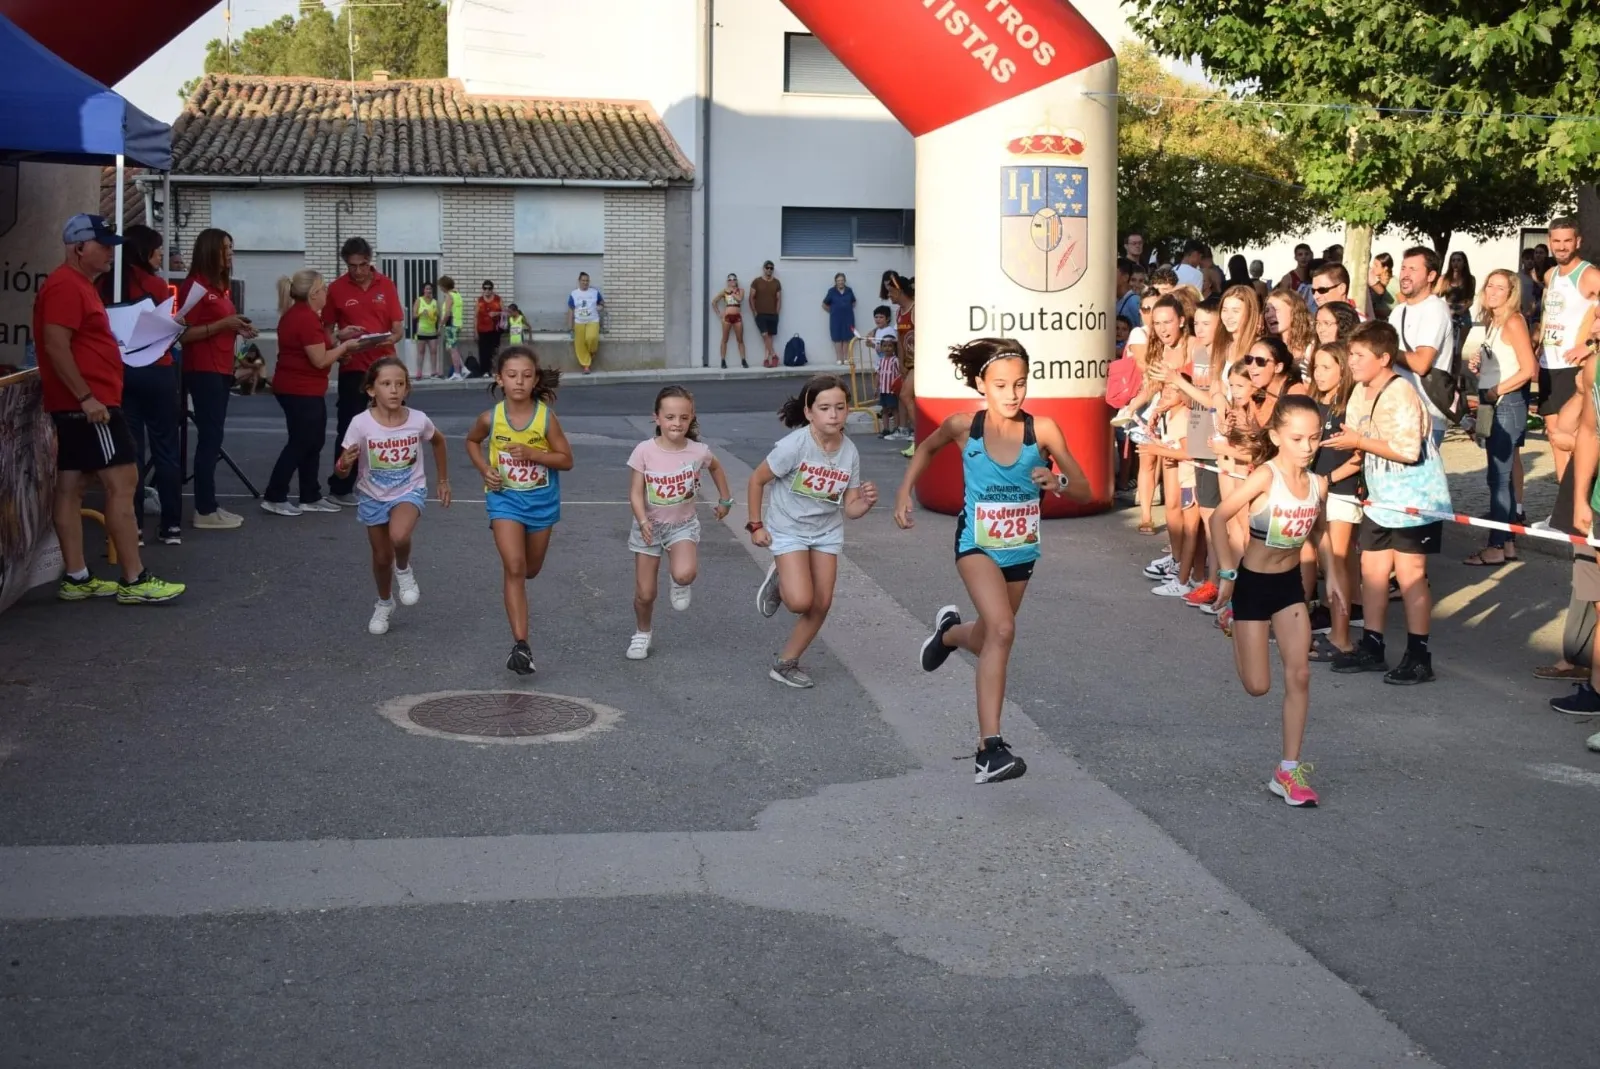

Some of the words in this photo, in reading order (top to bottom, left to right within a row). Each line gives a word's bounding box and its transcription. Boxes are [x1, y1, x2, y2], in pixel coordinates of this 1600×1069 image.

[969, 303, 1107, 337] Diputación
[1032, 360, 1111, 380] amanc
[368, 436, 418, 449] bedunia
[378, 447, 411, 463] 432
[507, 467, 539, 482] 426
[645, 470, 693, 485] bedunia
[799, 462, 850, 482] bedunia
[656, 482, 687, 499] 425
[802, 475, 836, 493] 431
[976, 504, 1039, 520] bedunia
[988, 517, 1027, 539] 428
[1281, 518, 1313, 538] 429
